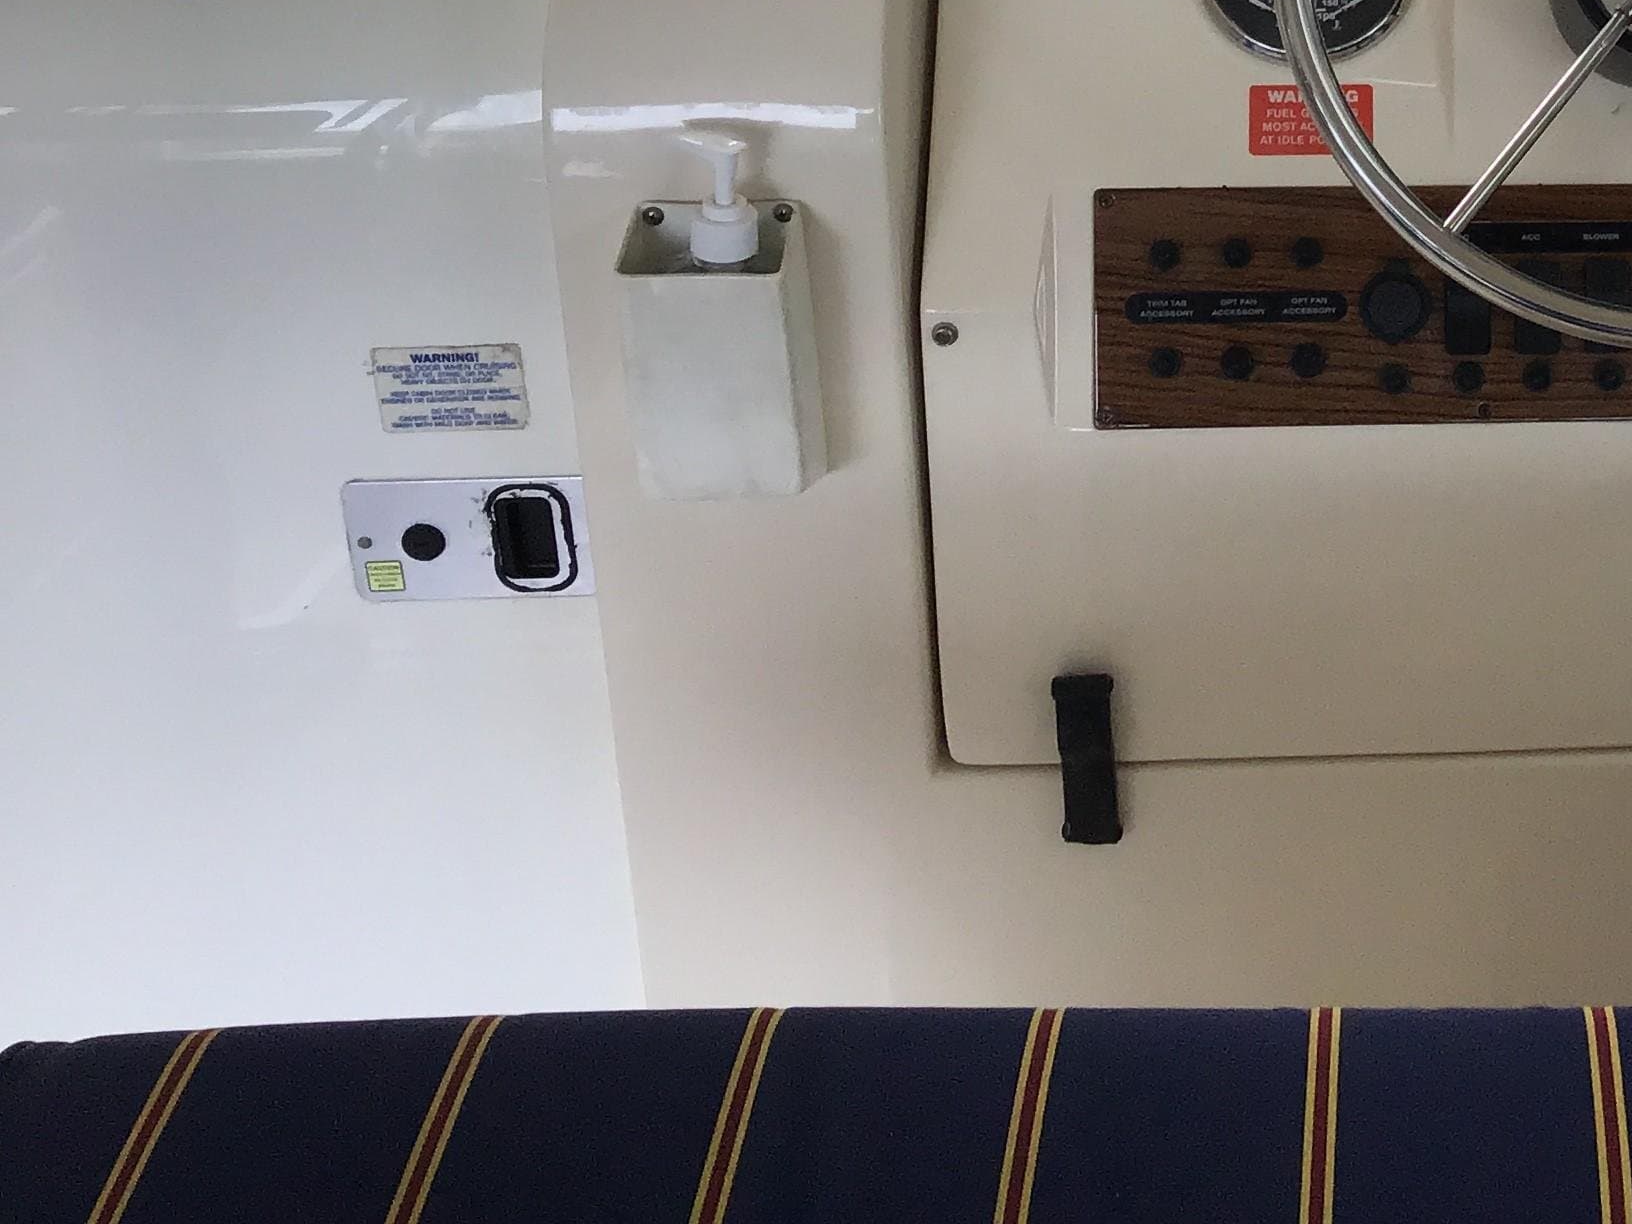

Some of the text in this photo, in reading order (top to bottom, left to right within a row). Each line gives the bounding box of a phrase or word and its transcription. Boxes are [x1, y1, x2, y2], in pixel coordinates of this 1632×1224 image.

[1266, 108, 1297, 118] FUEL
[1262, 122, 1296, 132] MOST
[1260, 136, 1273, 145] AT
[1278, 135, 1305, 145] IDLE
[410, 352, 479, 364] WARNING!
